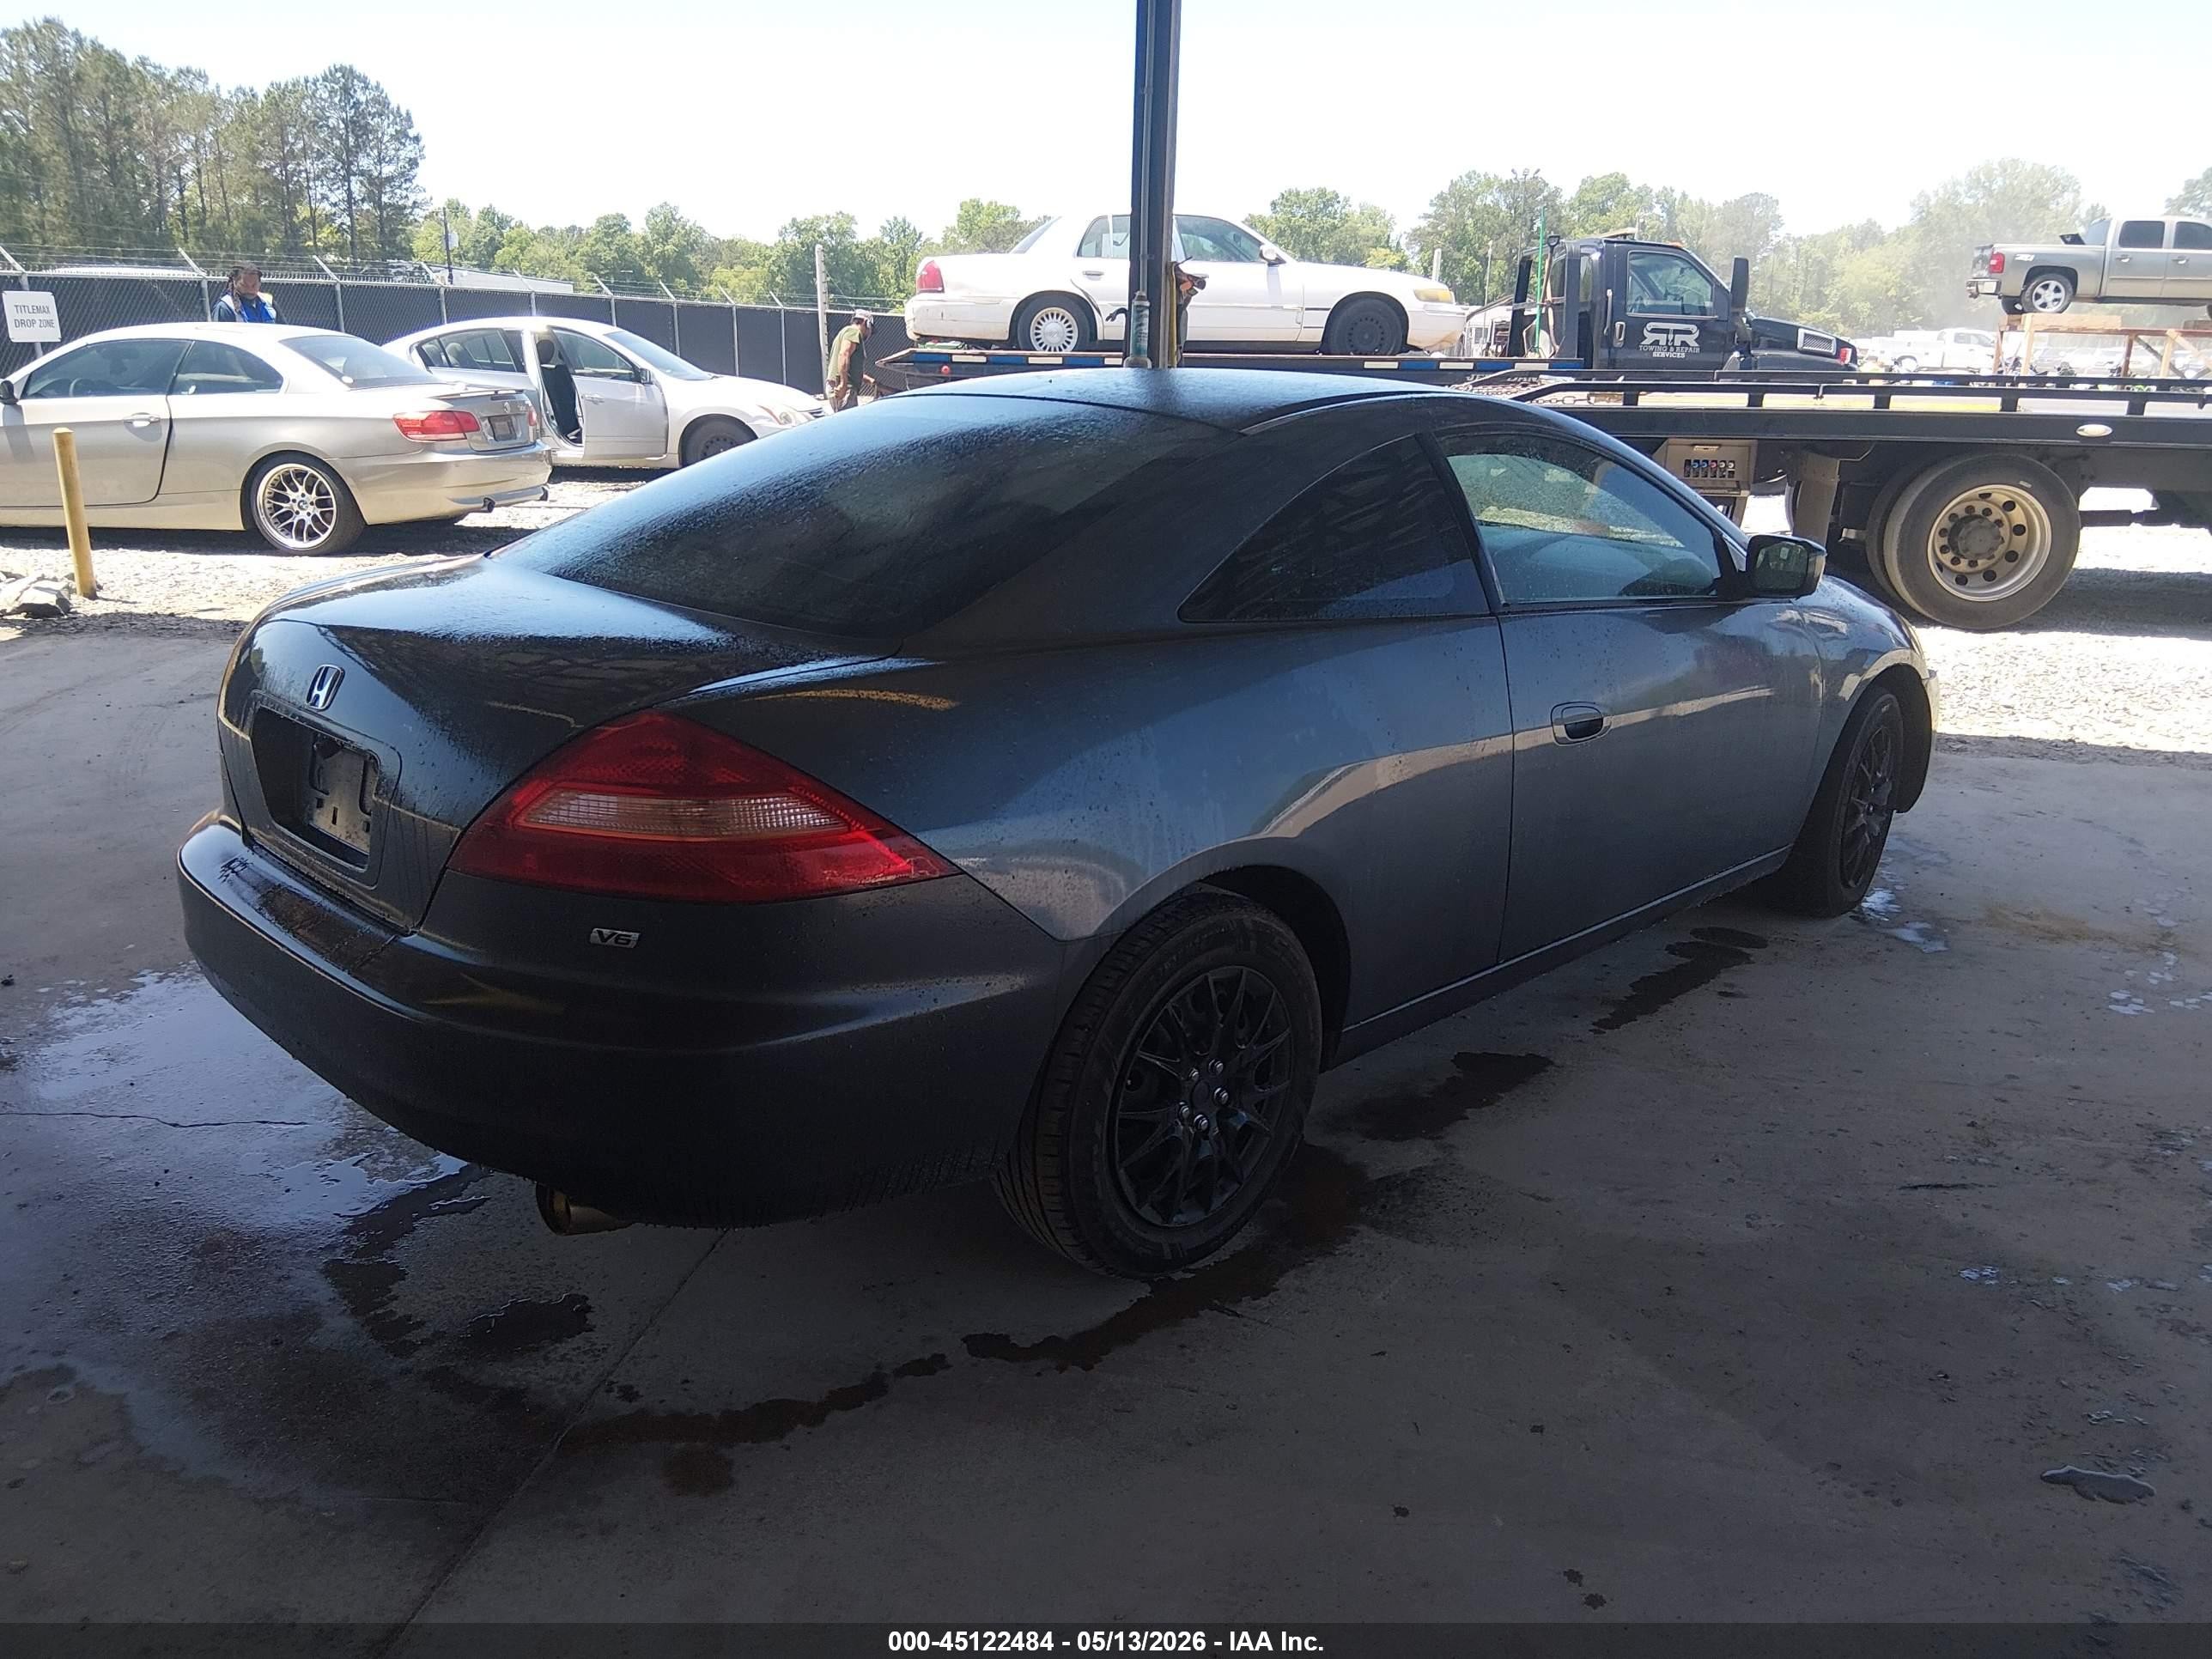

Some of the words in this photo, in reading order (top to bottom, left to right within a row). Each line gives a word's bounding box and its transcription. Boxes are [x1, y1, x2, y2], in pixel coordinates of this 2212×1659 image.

[14, 304, 51, 314] TITLEMAX
[14, 319, 36, 328] DROP
[38, 319, 55, 328] ZONE
[595, 928, 637, 947] V6
